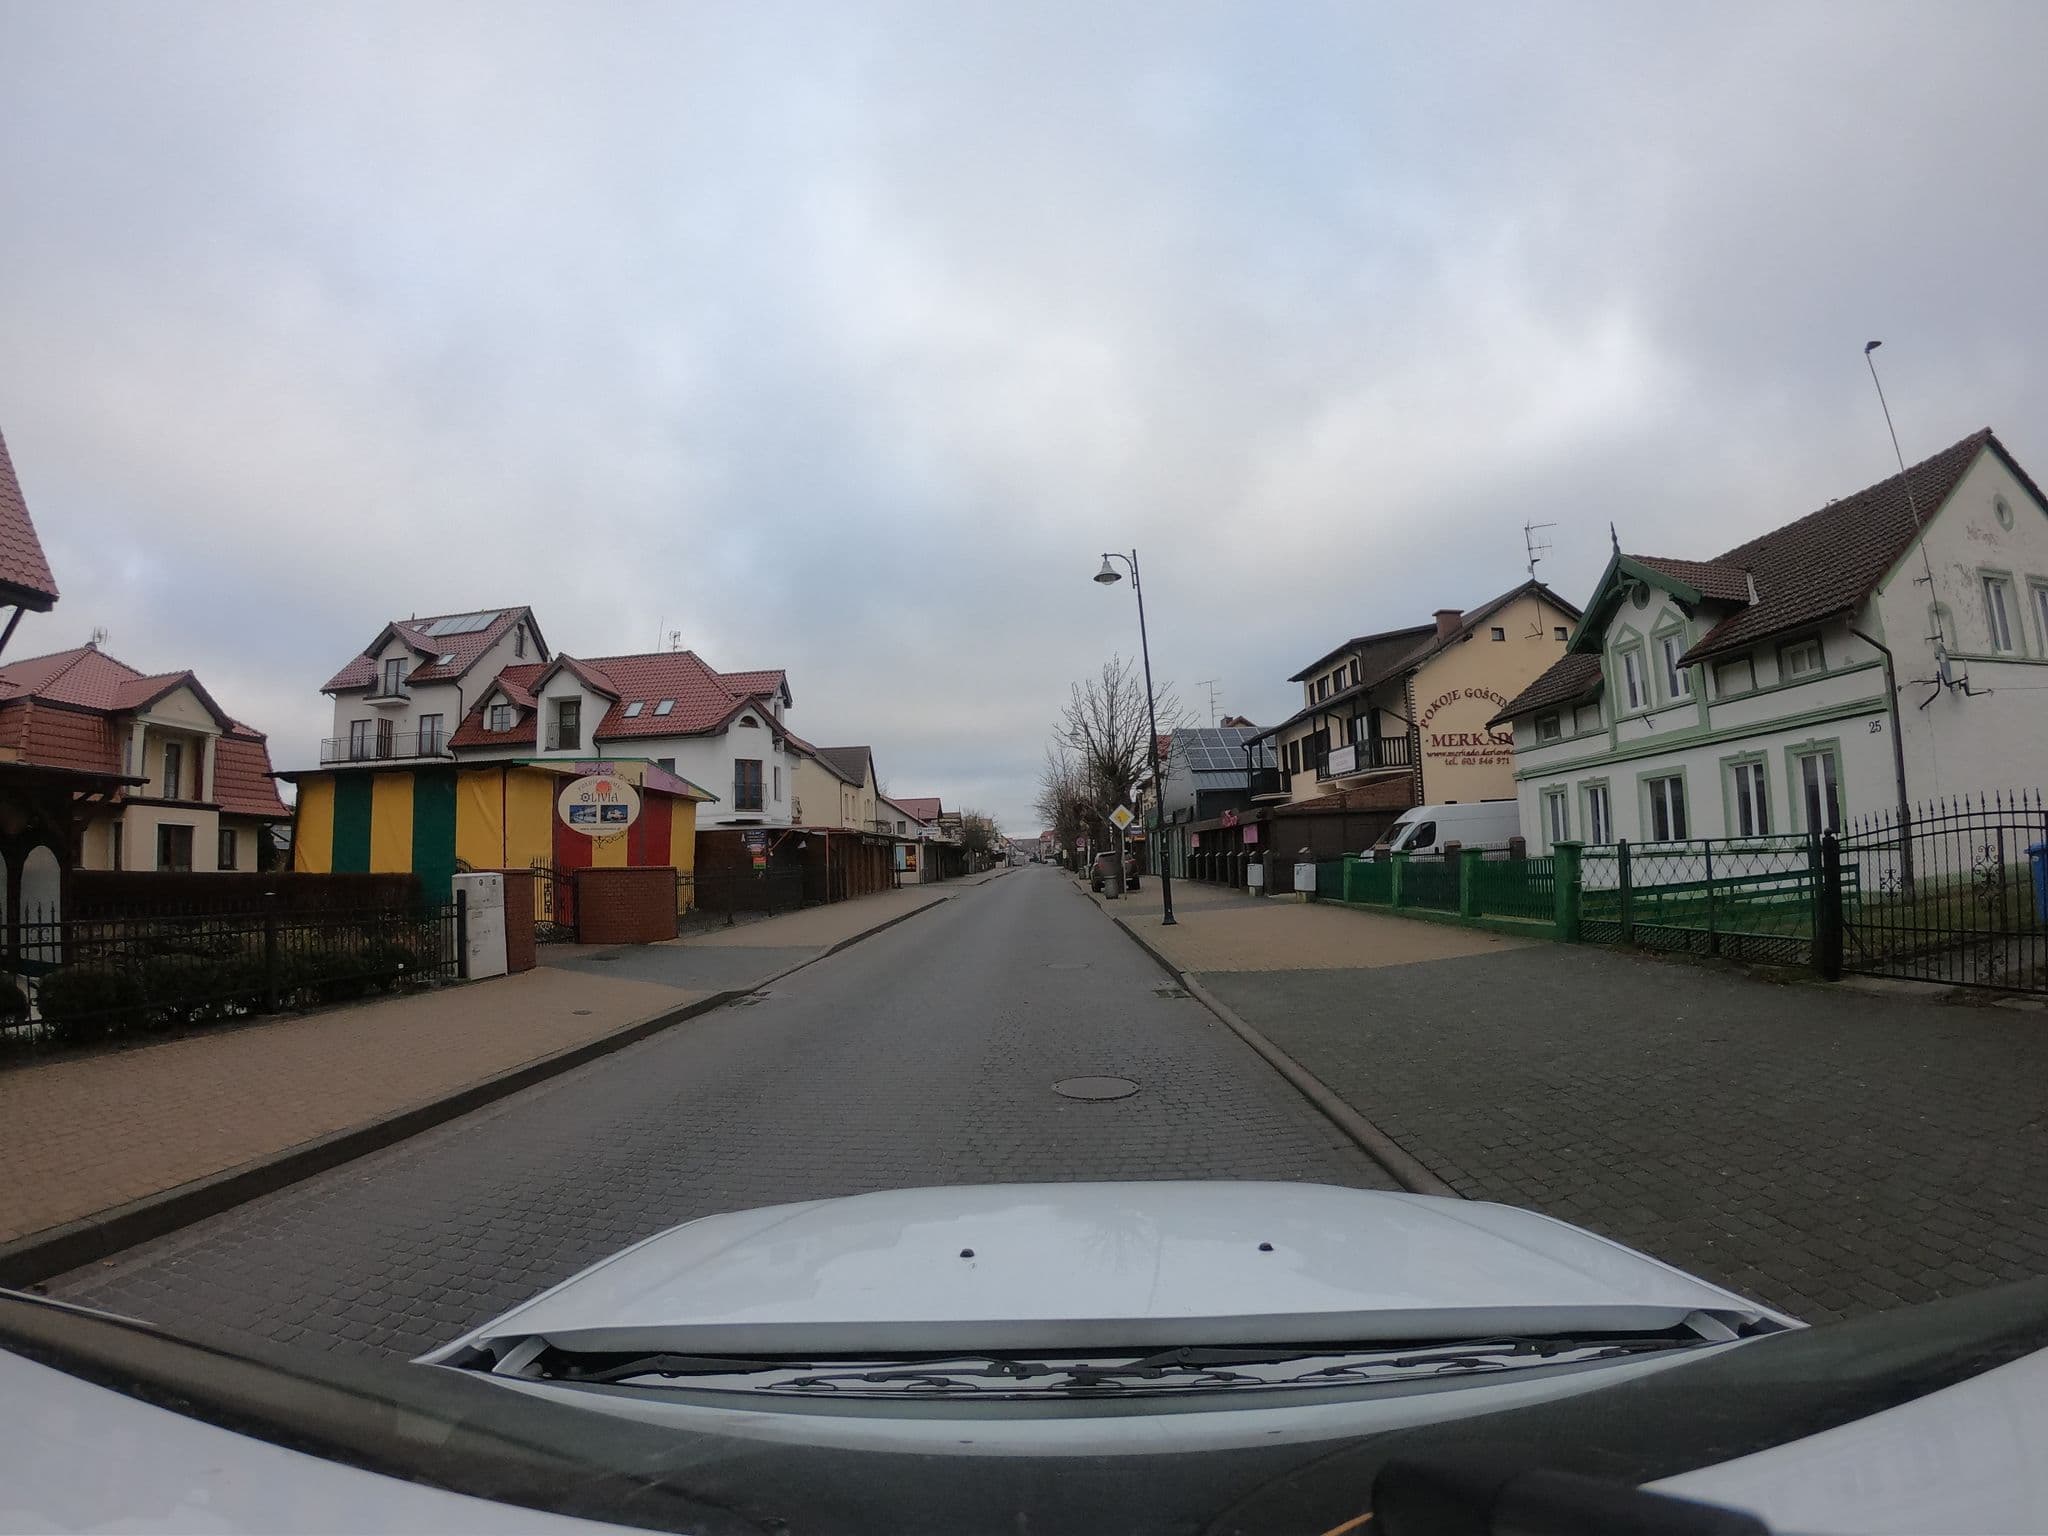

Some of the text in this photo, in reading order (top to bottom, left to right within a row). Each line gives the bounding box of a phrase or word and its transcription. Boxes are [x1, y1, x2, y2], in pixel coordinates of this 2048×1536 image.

[1420, 689, 1461, 729] POKOJE
[1868, 719, 1882, 734] 25
[1445, 757, 1458, 766] tel.
[580, 792, 619, 803] OLIVIA
